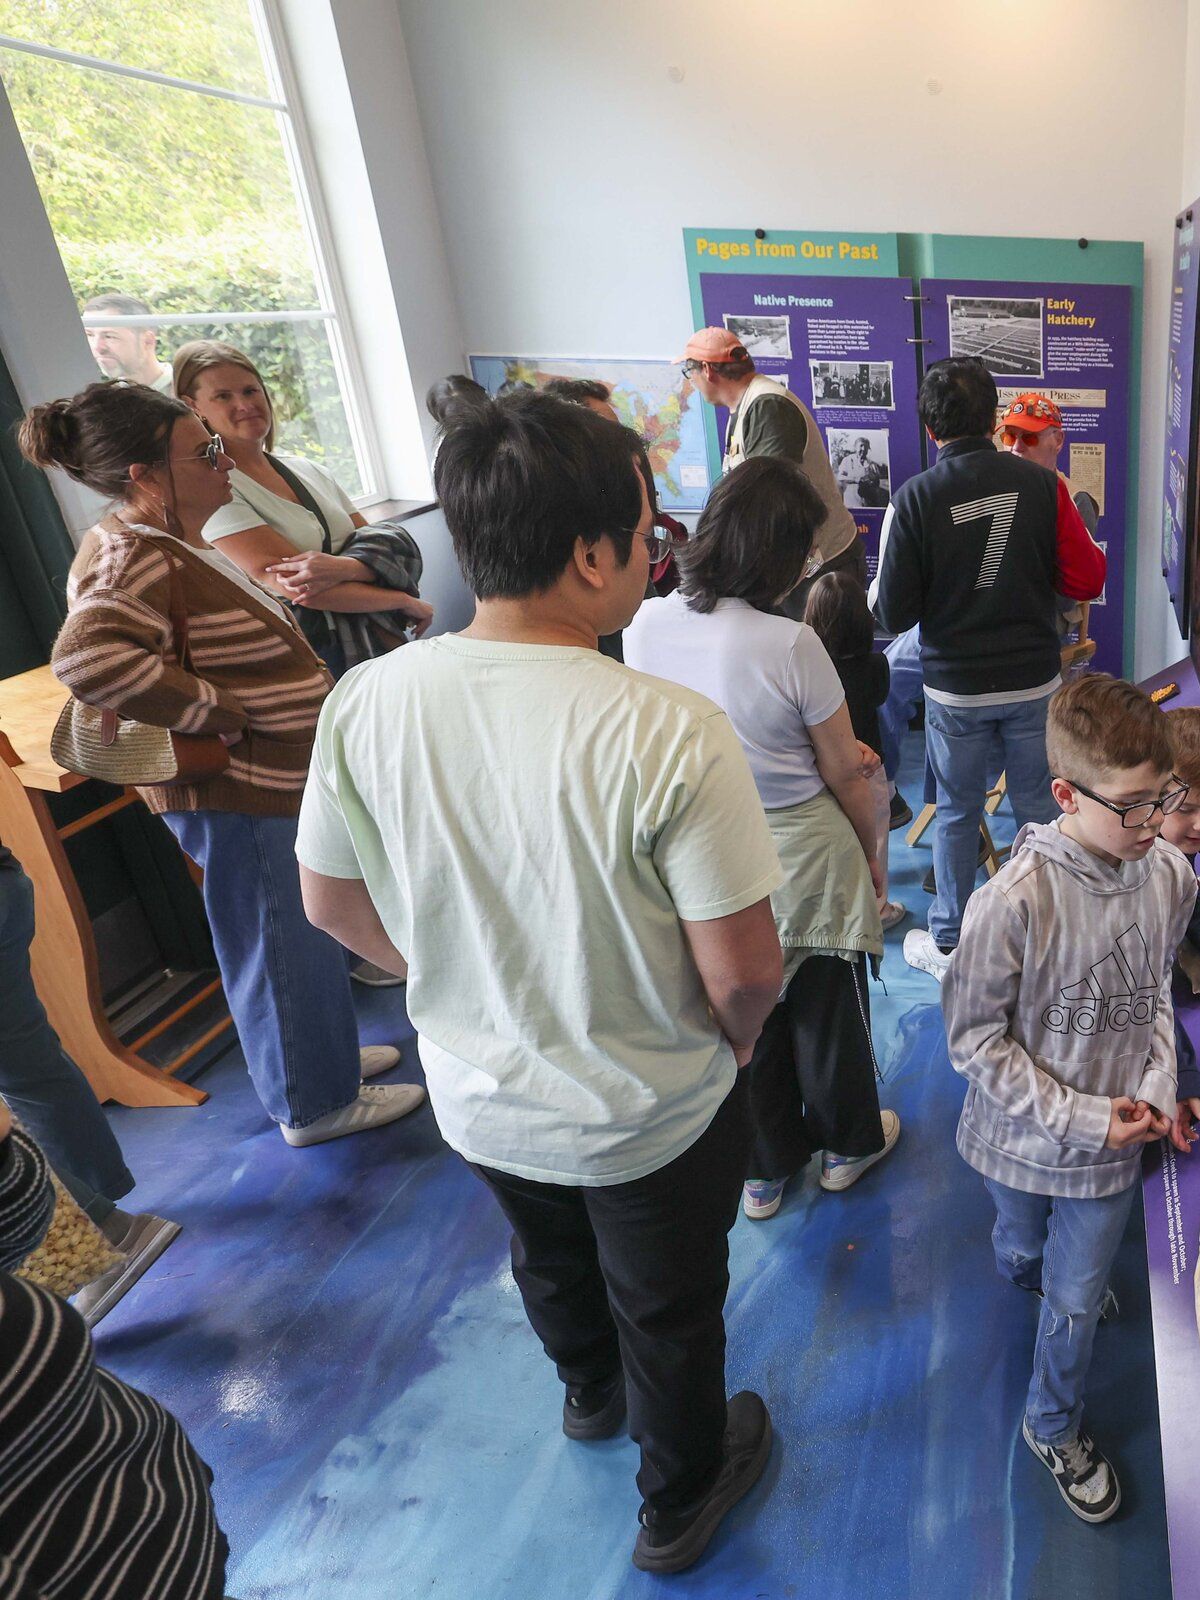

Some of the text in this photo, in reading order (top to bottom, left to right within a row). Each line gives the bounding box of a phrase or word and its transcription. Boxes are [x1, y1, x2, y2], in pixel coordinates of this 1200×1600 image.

[696, 238, 879, 260] Pages from Our Past
[754, 294, 834, 307] Native Presence
[1047, 298, 1076, 312] Early
[1047, 314, 1096, 328] Hatchery
[1050, 390, 1080, 400] PRESS
[950, 492, 1019, 590] 7
[1174, 1203, 1183, 1233] September
[1168, 1218, 1176, 1242] through
[1172, 1253, 1180, 1284] November
